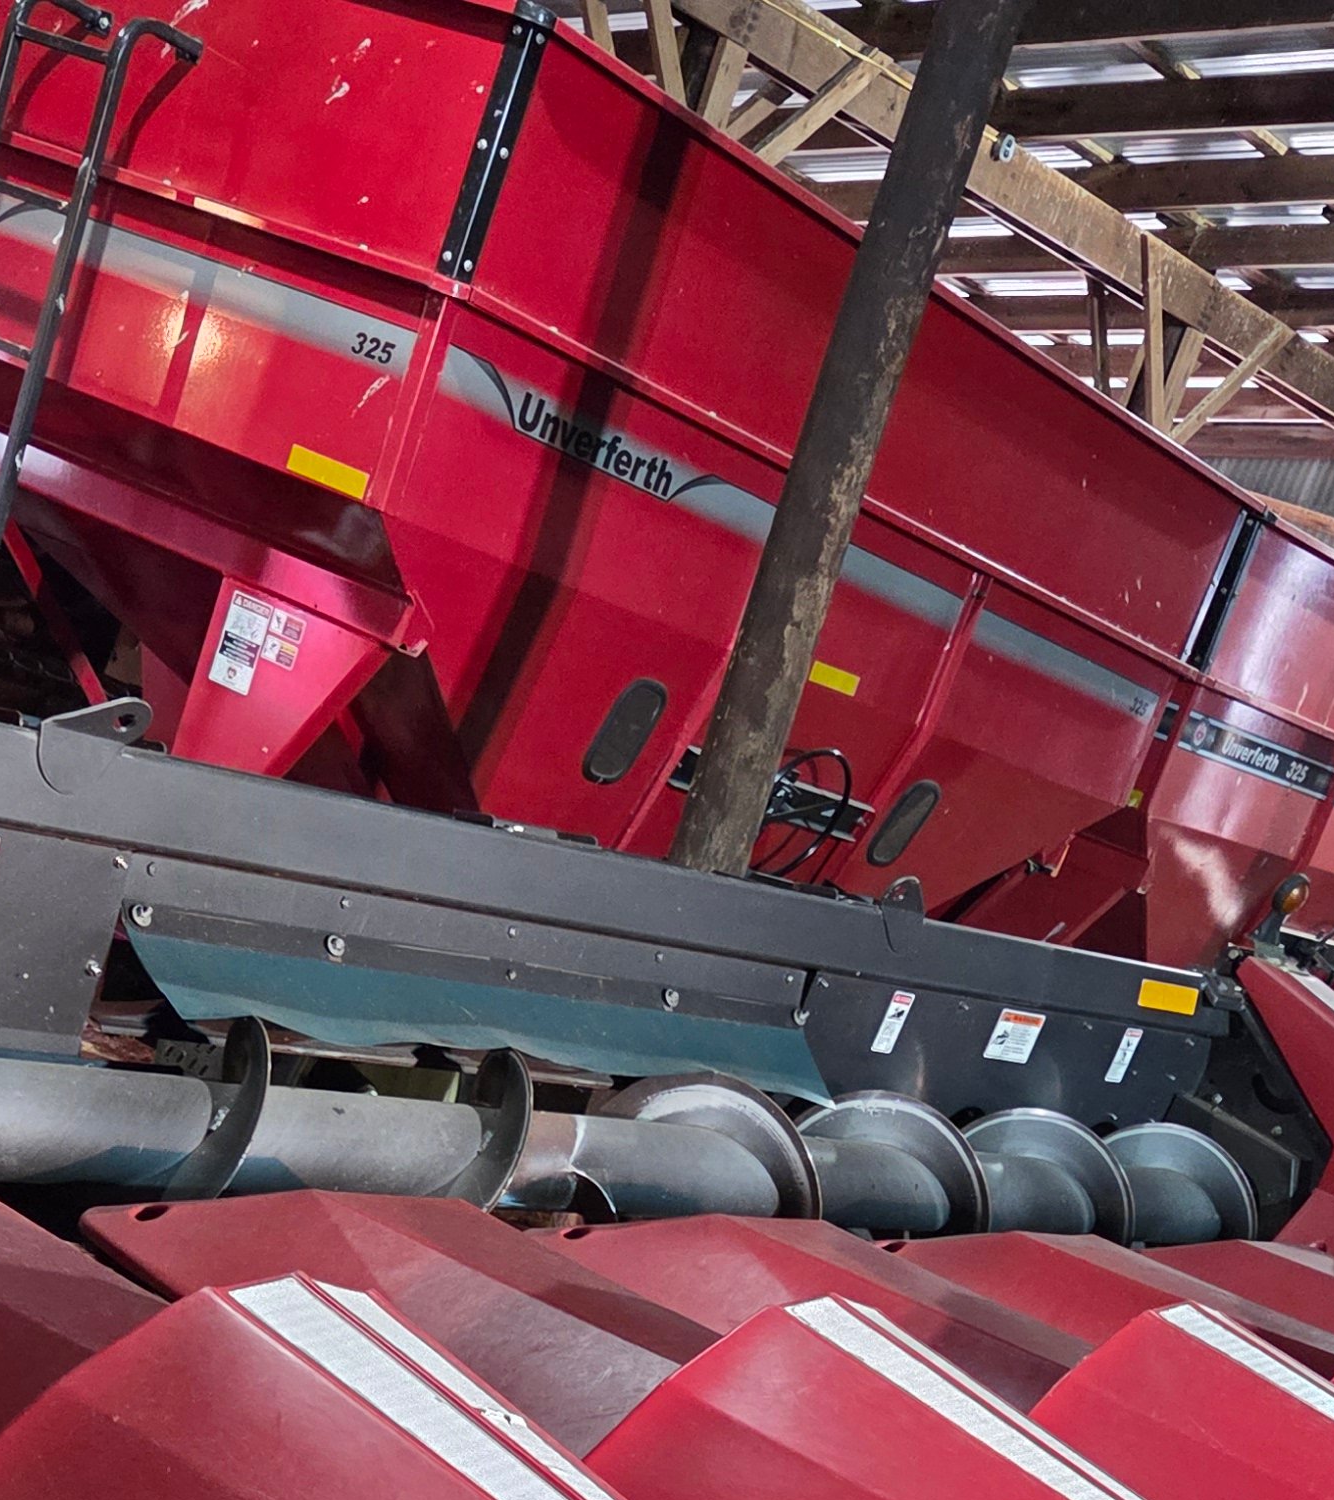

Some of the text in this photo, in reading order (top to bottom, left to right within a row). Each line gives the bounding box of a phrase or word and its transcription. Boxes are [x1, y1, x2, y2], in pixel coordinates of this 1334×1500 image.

[351, 332, 396, 364] 325
[518, 391, 673, 497] Unverferth
[1129, 697, 1149, 717] 325
[1221, 734, 1310, 783] Unverferth 325
